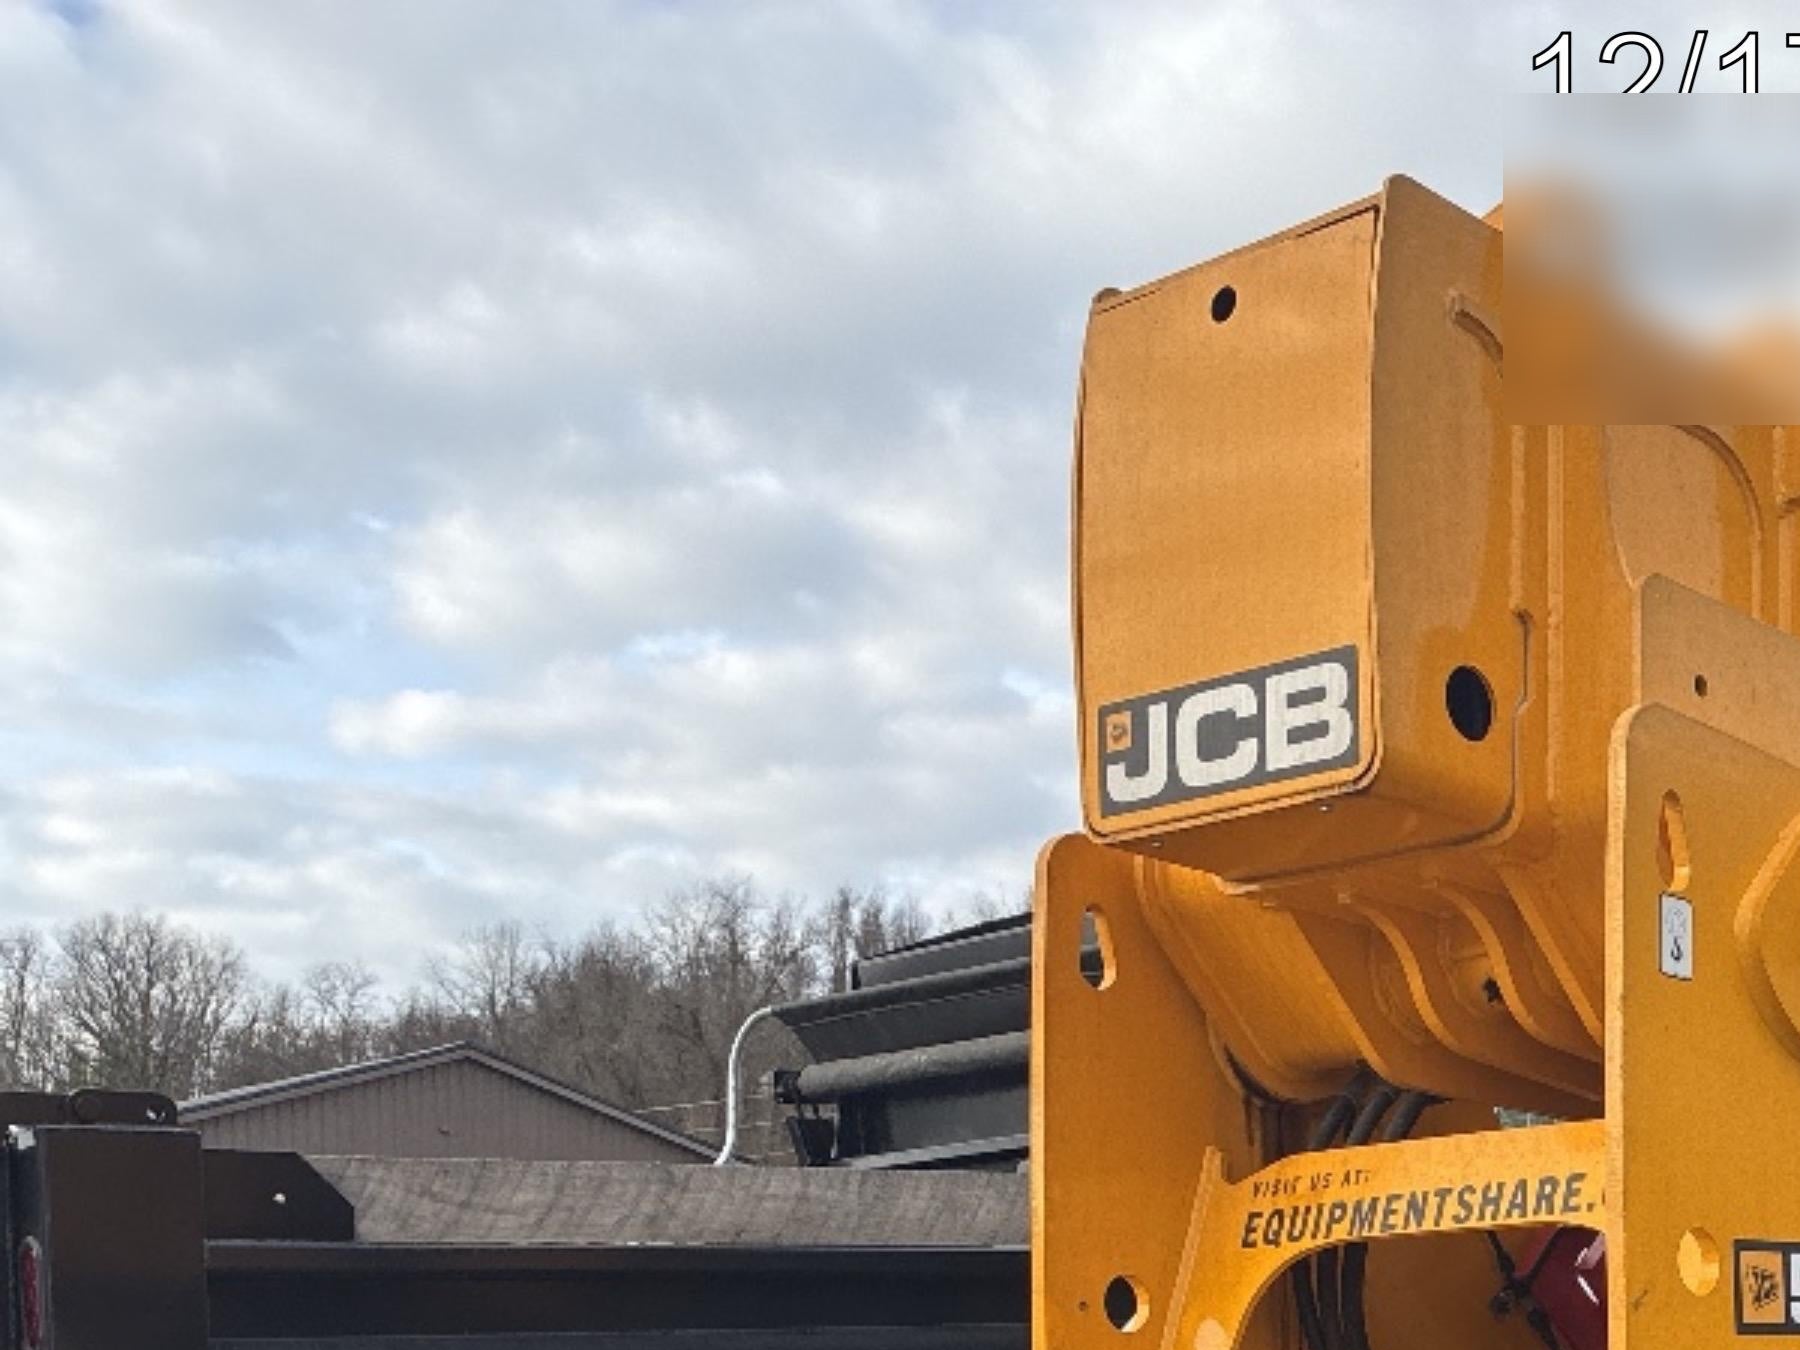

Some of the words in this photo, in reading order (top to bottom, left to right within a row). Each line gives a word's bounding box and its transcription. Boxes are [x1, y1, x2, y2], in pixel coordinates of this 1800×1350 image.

[1106, 662, 1353, 802] JCB
[1241, 1172, 1606, 1249] EQUIPMENTSHARE.
[1252, 1175, 1303, 1198] VISIT
[1309, 1172, 1333, 1192] US
